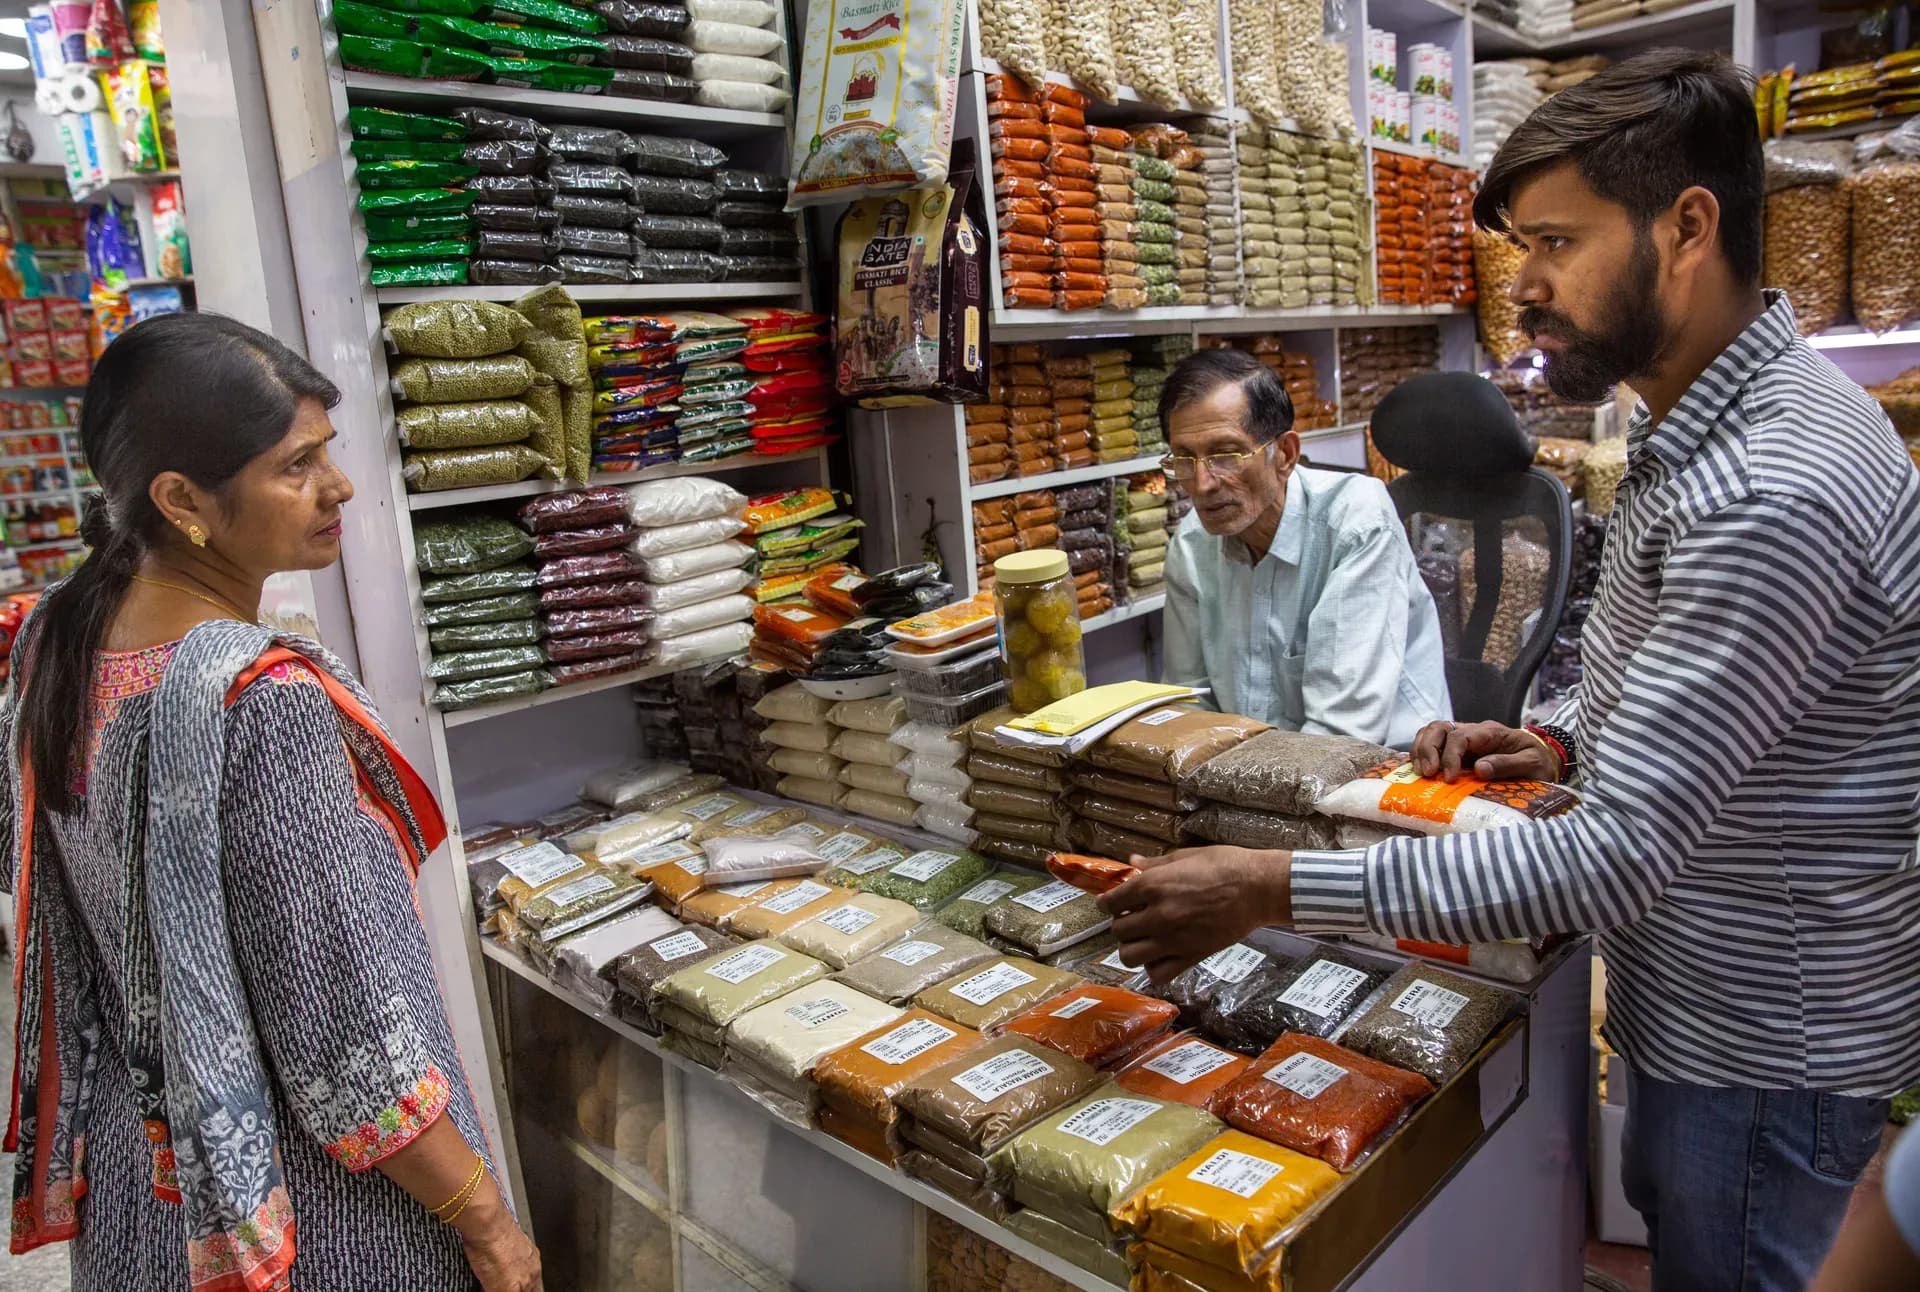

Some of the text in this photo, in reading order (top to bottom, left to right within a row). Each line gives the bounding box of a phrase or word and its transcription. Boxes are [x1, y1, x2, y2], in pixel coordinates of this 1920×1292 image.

[841, 2, 880, 17] Basmati
[867, 240, 909, 255] INDIA
[864, 250, 905, 263] GATE
[857, 267, 907, 280] BASMATI RICE
[864, 278, 894, 288] CLASSIC
[1344, 973, 1361, 988] KALI
[1322, 987, 1347, 1009] MIRCH
[1397, 984, 1425, 1010] JEERA
[923, 1031, 950, 1047] CHICKEN
[898, 1044, 924, 1060] MASALA
[1284, 1056, 1310, 1073] MIRCH
[992, 1065, 1047, 1093] GARAM MASALA
[1196, 1150, 1230, 1177] HALDI
